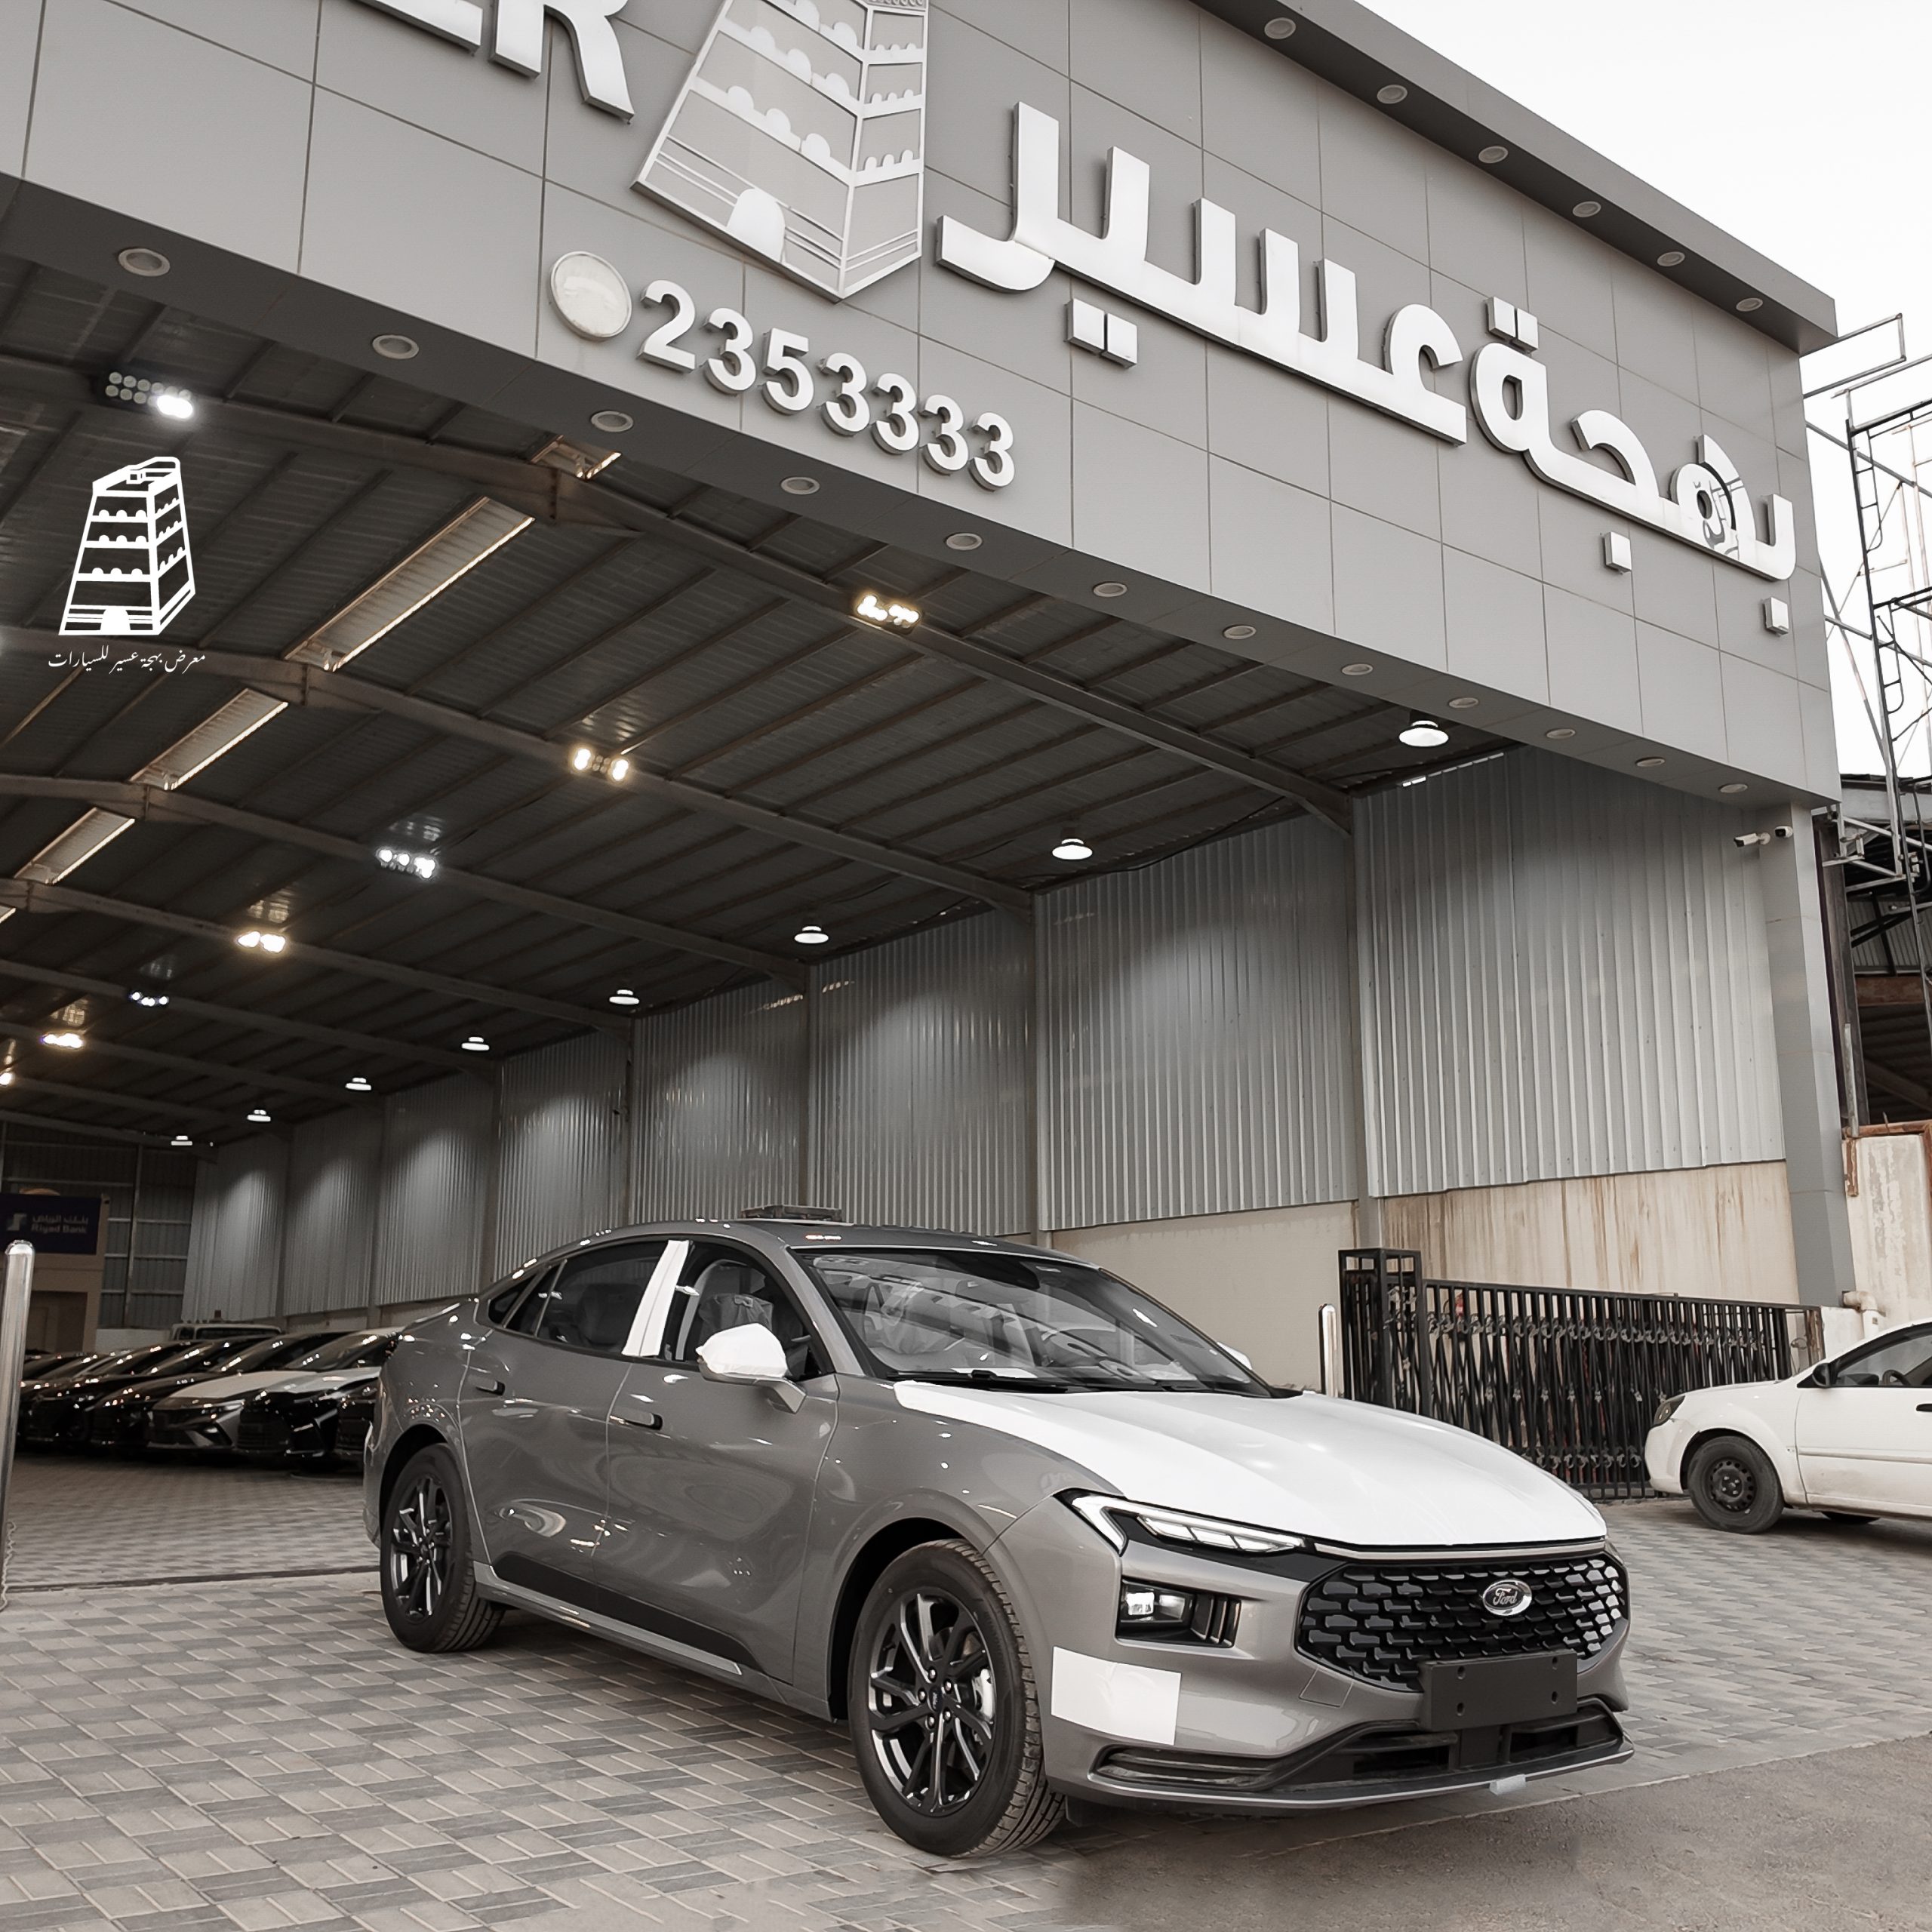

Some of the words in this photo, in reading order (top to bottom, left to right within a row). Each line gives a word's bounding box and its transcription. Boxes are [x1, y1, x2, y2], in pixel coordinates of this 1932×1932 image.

[936, 101, 1468, 448] عسير
[637, 280, 1015, 493] 2353333
[1470, 296, 1796, 638] بهجة
[63, 1223, 88, 1233] Bank
[1493, 1587, 1518, 1605] Ford
